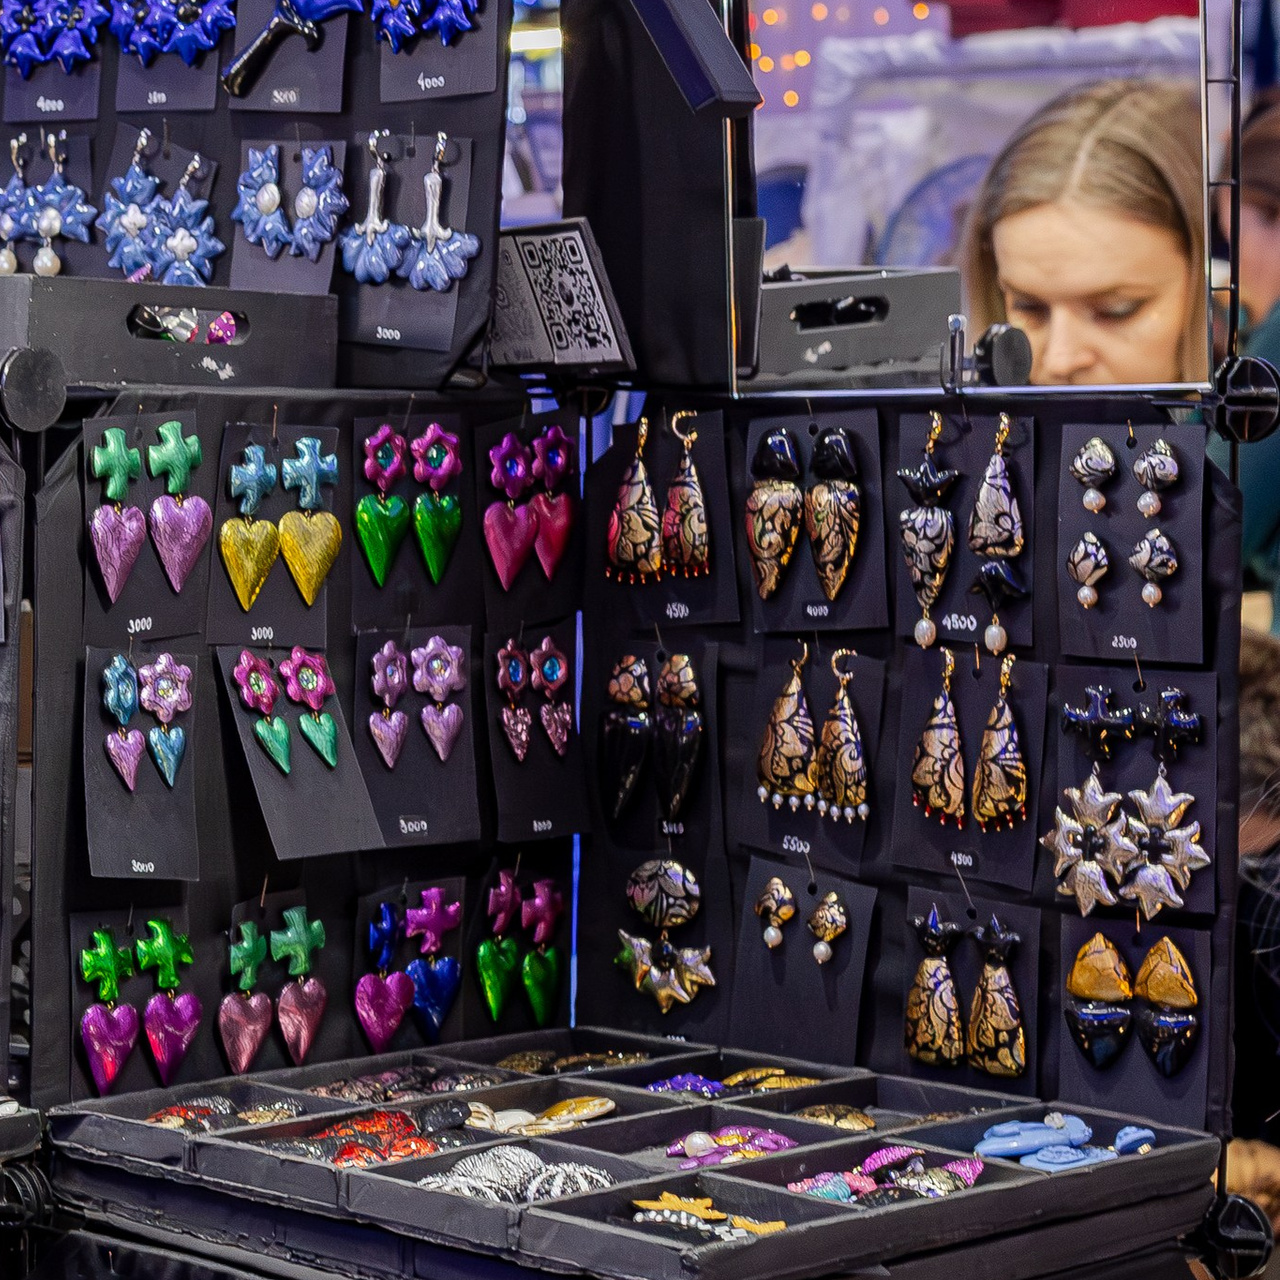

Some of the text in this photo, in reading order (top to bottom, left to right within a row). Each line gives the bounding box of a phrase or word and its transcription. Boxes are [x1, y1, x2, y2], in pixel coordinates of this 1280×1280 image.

[416, 71, 444, 91] 4000
[375, 325, 400, 341] 3000
[127, 616, 152, 634] 3000
[941, 613, 978, 632] 4500
[251, 626, 273, 641] 3000
